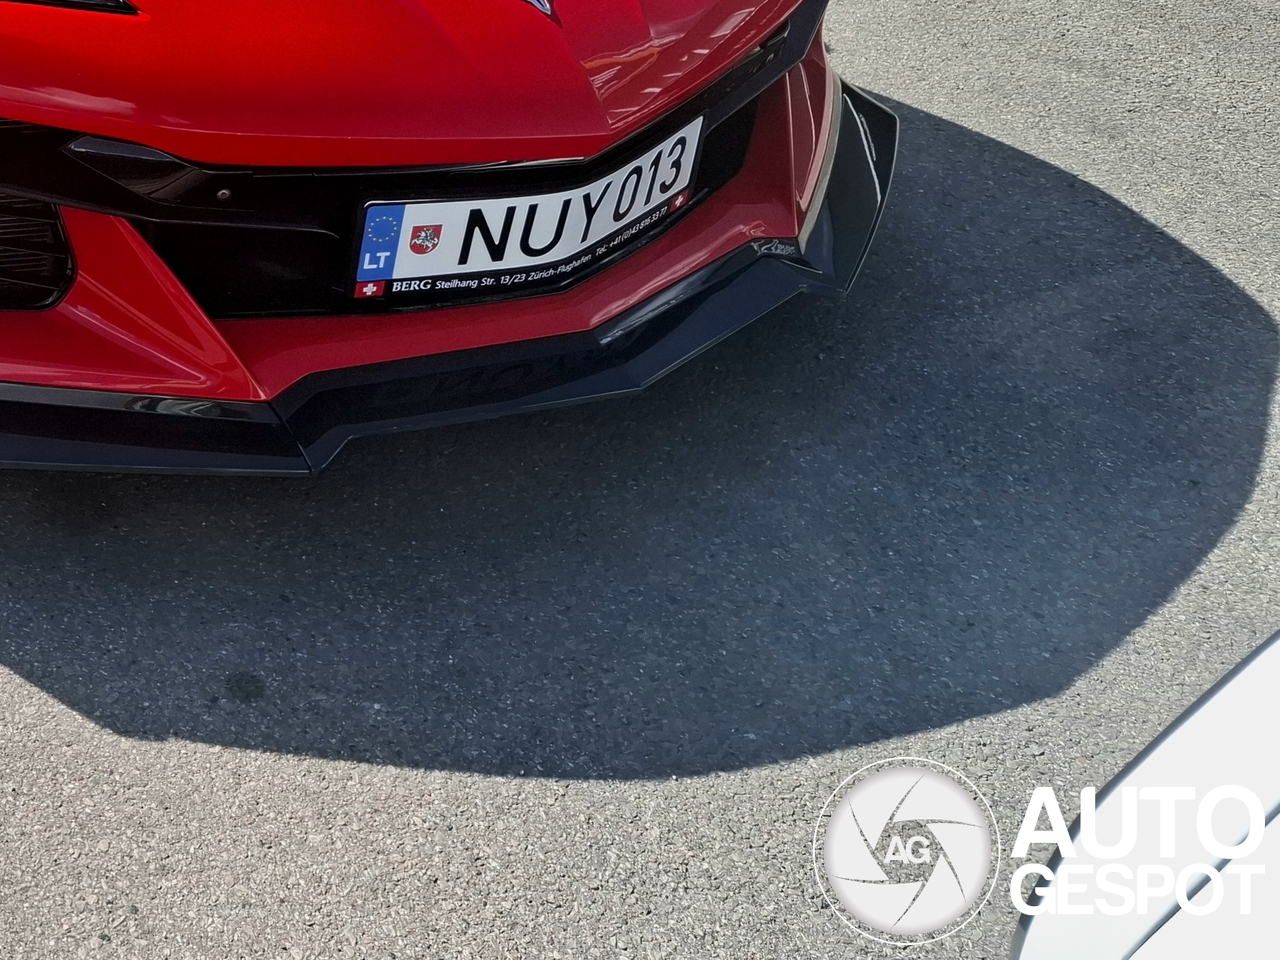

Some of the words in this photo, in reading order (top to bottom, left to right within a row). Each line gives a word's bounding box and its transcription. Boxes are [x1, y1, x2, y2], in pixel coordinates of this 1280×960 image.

[363, 251, 391, 270] LT
[392, 280, 432, 292] BERG
[435, 277, 479, 291] Steilhang
[480, 276, 497, 287] Str.
[500, 273, 526, 286] 13/23
[527, 254, 592, 281] Zürich-Flughafen
